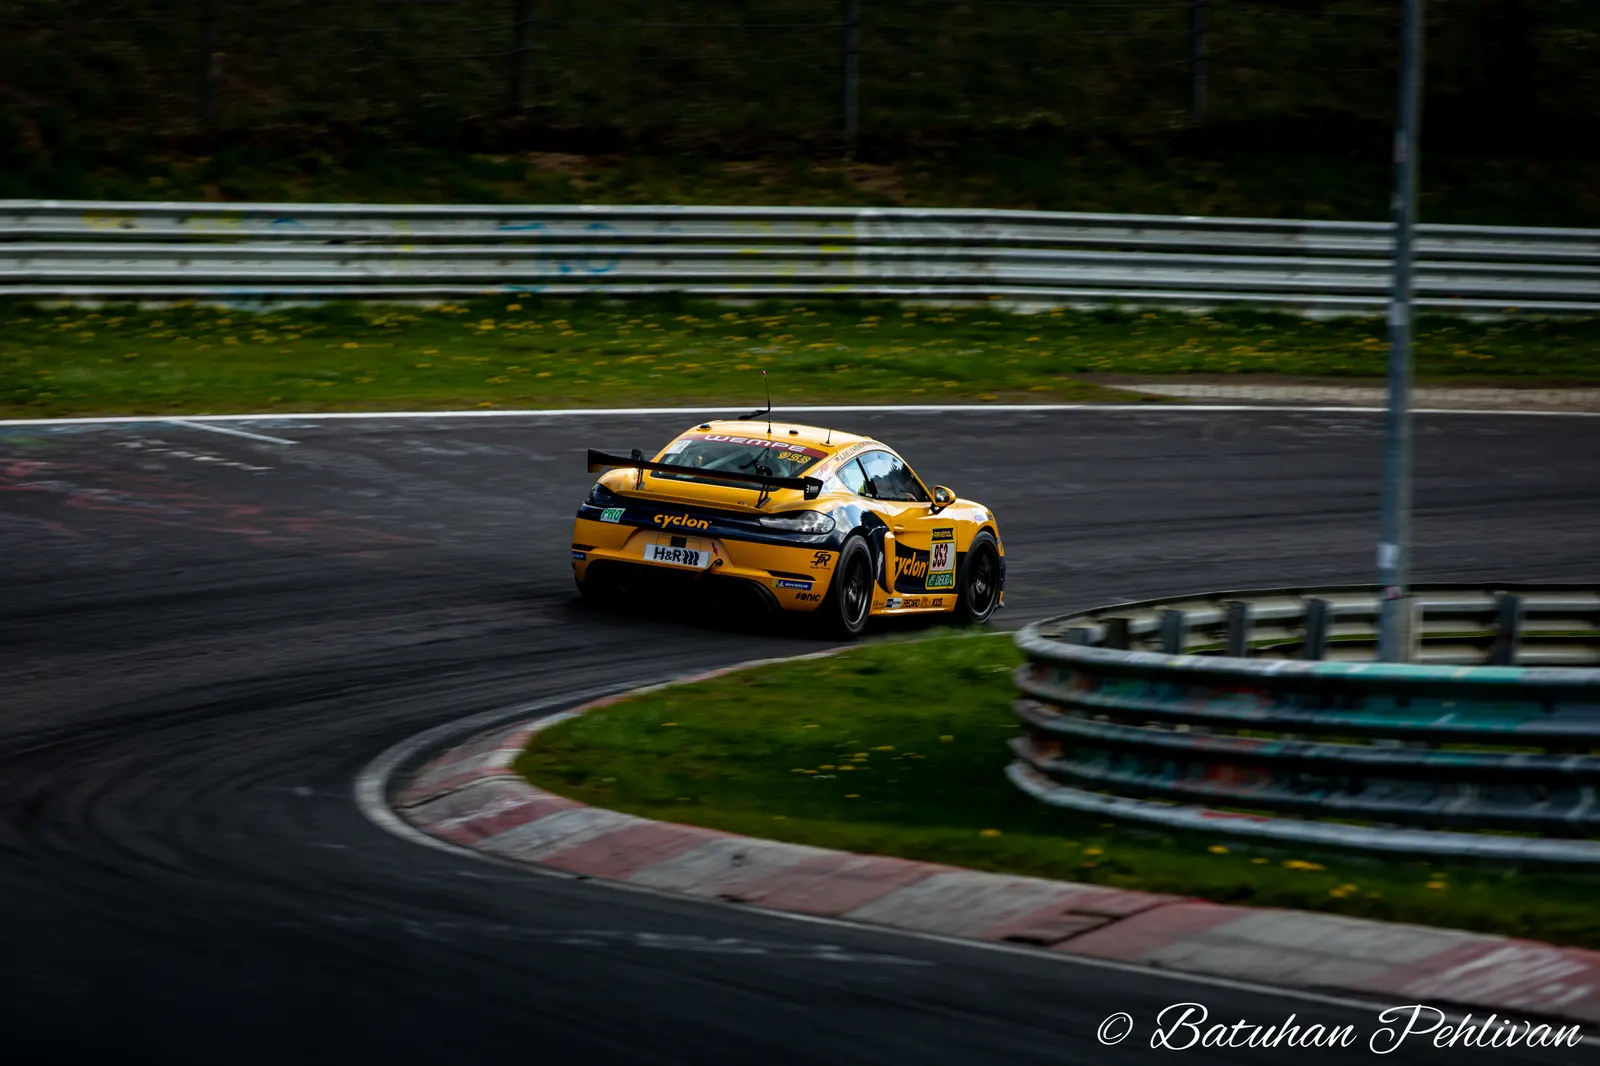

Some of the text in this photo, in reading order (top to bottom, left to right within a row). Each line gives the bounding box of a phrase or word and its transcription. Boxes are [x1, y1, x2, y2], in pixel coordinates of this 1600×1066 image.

[704, 434, 807, 453] WEMPE
[777, 451, 812, 465] 953
[601, 508, 623, 521] PRO
[653, 513, 709, 530] cyclon
[932, 543, 949, 568] 953
[934, 574, 953, 586] DEKRA
